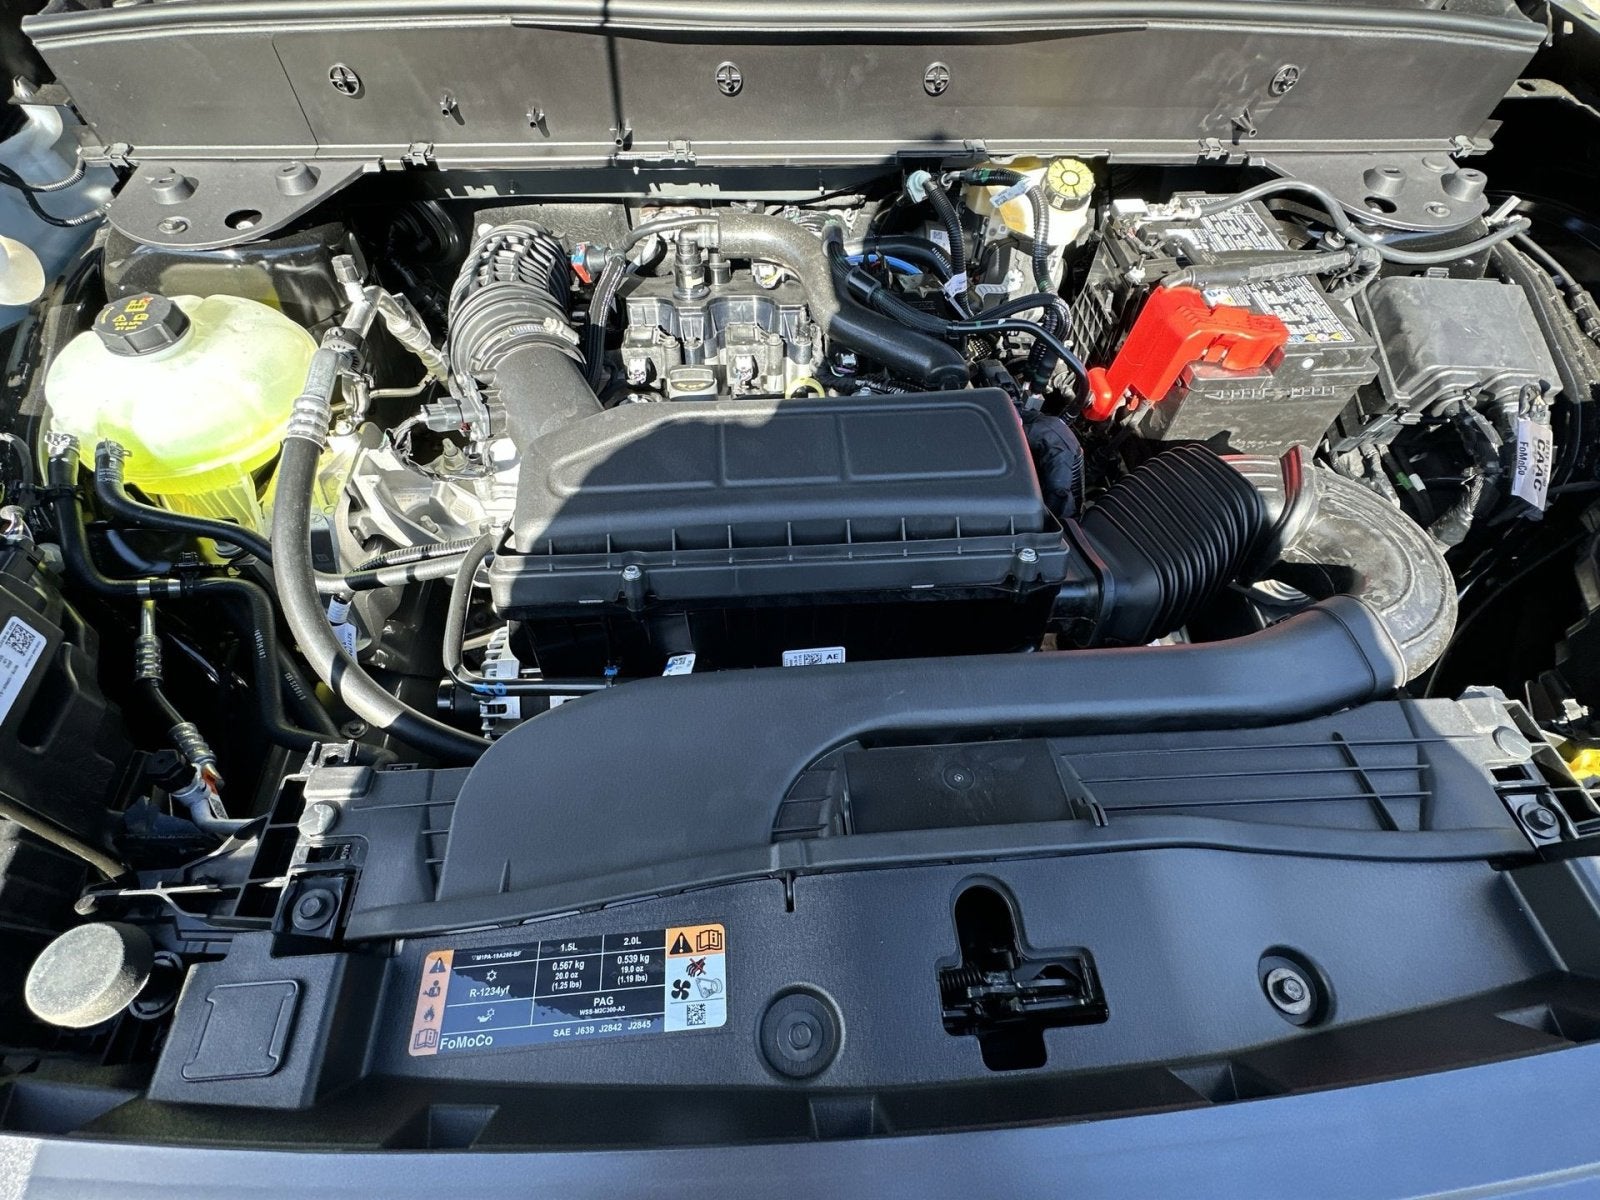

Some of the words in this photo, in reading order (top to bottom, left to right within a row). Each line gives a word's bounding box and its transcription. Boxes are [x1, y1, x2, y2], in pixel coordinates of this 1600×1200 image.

[1518, 442, 1529, 475] FoMoCo
[1534, 439, 1546, 491] CAAC
[623, 936, 642, 946] 2.0L
[561, 943, 578, 952] 1.5L
[617, 954, 638, 965] 0.539
[640, 954, 650, 964] kg
[552, 962, 574, 971] 0.567
[575, 960, 585, 970] kg
[620, 965, 634, 974] 19.0
[555, 972, 569, 980] 20.0
[635, 974, 648, 983] lbs)
[469, 985, 511, 998] R-1234yf
[551, 982, 569, 992] (1.25
[569, 980, 582, 990] lbs)
[593, 996, 614, 1007] PAG
[553, 1028, 571, 1038] SAE
[575, 1026, 595, 1036] J639
[598, 1023, 623, 1033] J2842
[627, 1020, 652, 1030] J2845
[439, 1033, 494, 1051] FoMoCo
